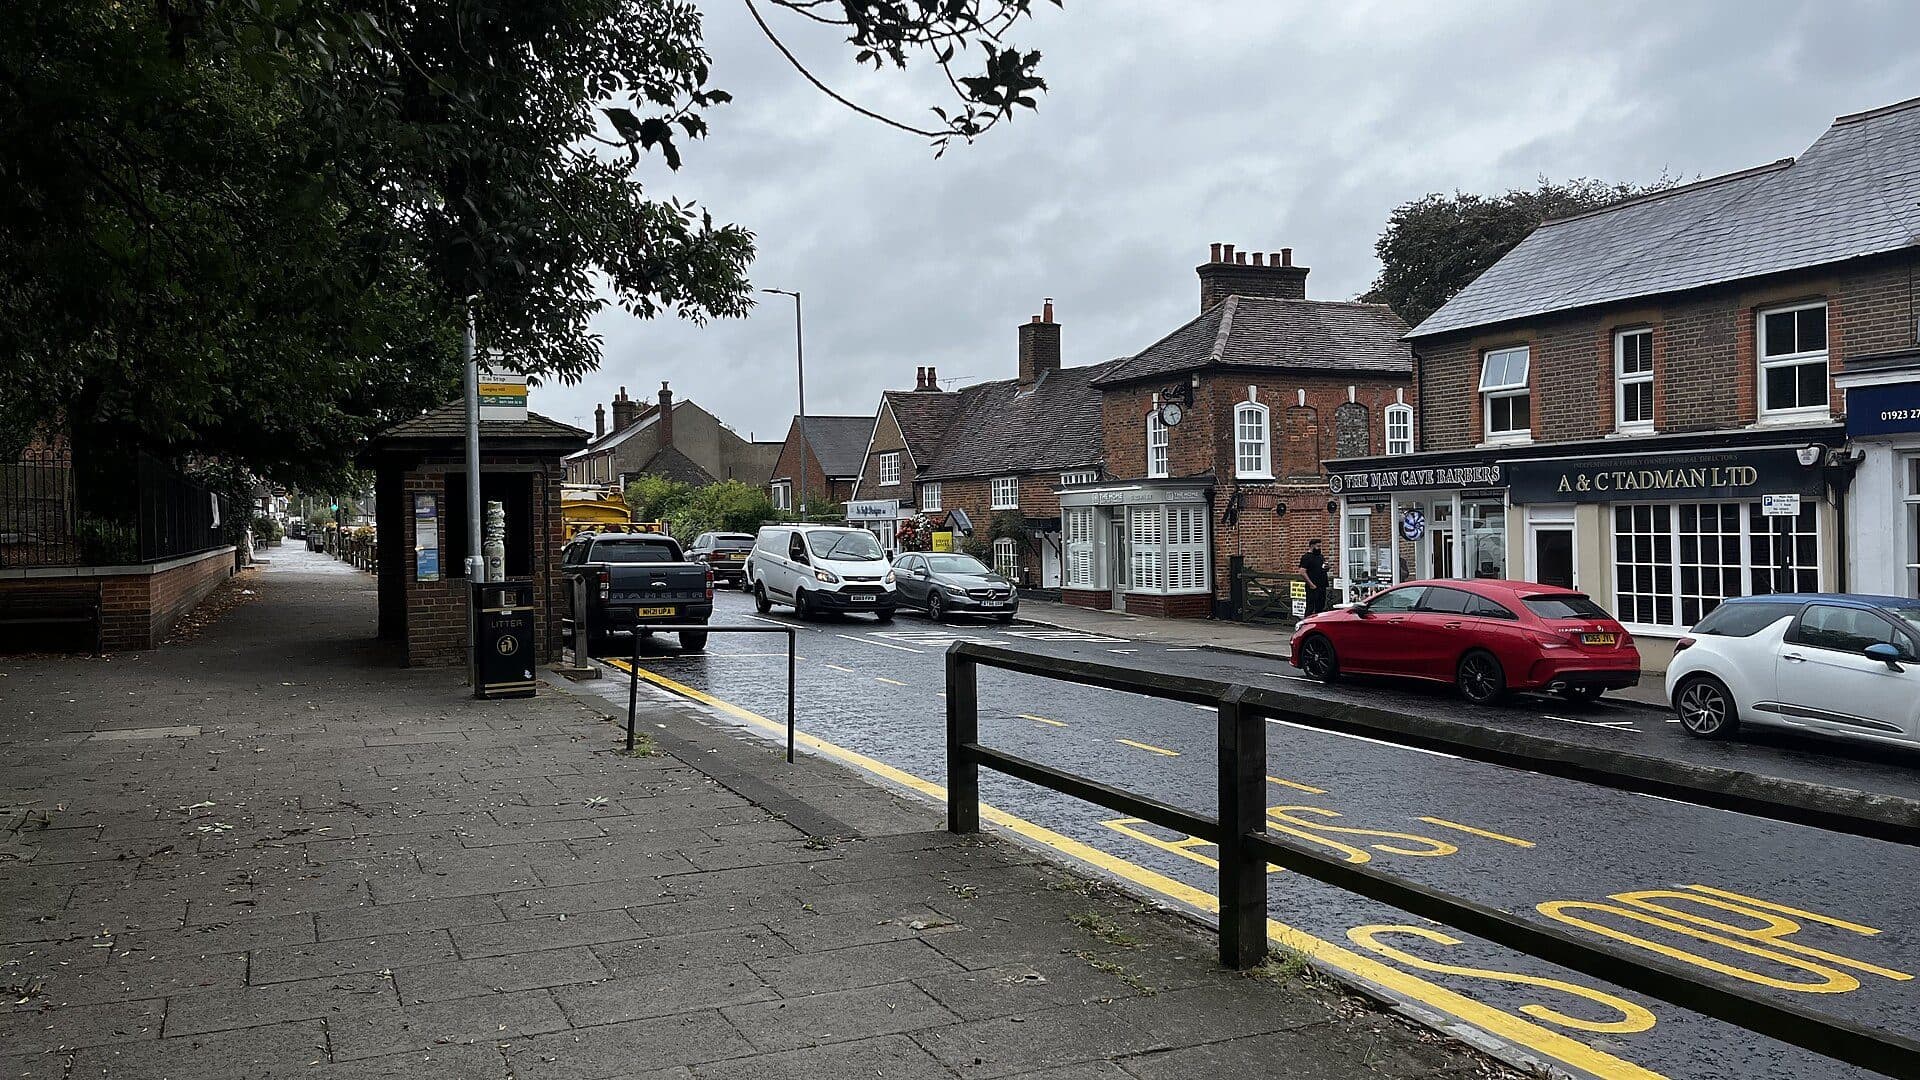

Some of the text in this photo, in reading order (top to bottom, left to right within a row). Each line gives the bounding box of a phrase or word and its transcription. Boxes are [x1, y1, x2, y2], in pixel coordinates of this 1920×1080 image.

[1881, 410, 1908, 421] 01923
[1344, 466, 1500, 490] THE MAN CAVE BARBERS
[1557, 466, 1757, 492] A & C TADMAN LTD
[491, 619, 523, 628] LITTER
[1345, 890, 1917, 1035] SOP
